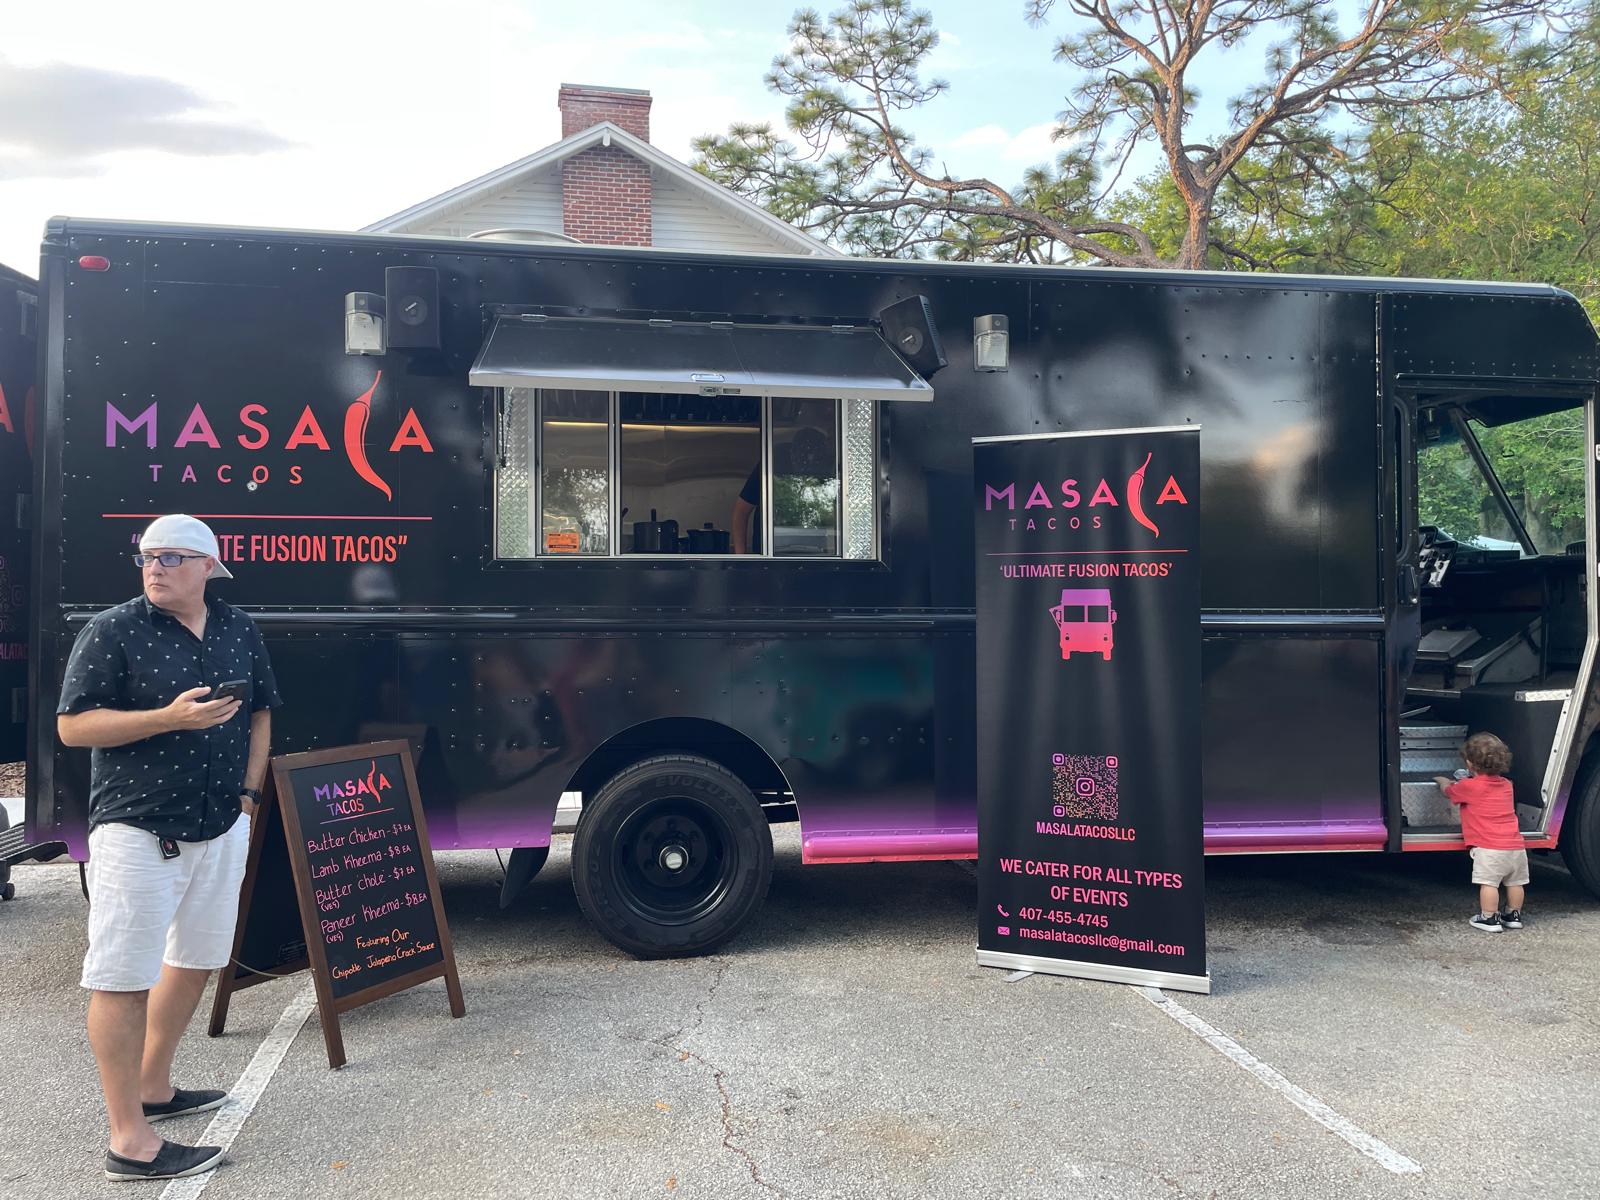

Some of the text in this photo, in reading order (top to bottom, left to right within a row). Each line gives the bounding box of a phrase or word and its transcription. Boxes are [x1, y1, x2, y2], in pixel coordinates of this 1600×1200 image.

[149, 464, 303, 484] TACOS
[1009, 516, 1101, 531] TACOS
[250, 534, 327, 562] FUSION
[1068, 564, 1119, 577] FUSION
[326, 798, 365, 817] TACOS
[307, 832, 345, 853] Butter
[348, 827, 386, 845] Chicken
[1036, 821, 1136, 841] MASALATACOSLLC
[311, 858, 340, 879] Lamb
[343, 850, 382, 870] Kheema
[1000, 858, 1183, 889] WE CATER FOR ALL TYPES
[315, 882, 353, 904] Butter
[1051, 885, 1129, 908] OF EVENTS
[321, 913, 356, 935] Paneer
[362, 898, 400, 922] Kheema
[1019, 906, 1109, 928] 407-455-4745
[356, 928, 410, 949] Featuring Our
[415, 941, 435, 953] Sauce
[1019, 927, 1185, 956] masalatacosllc@gmail.com
